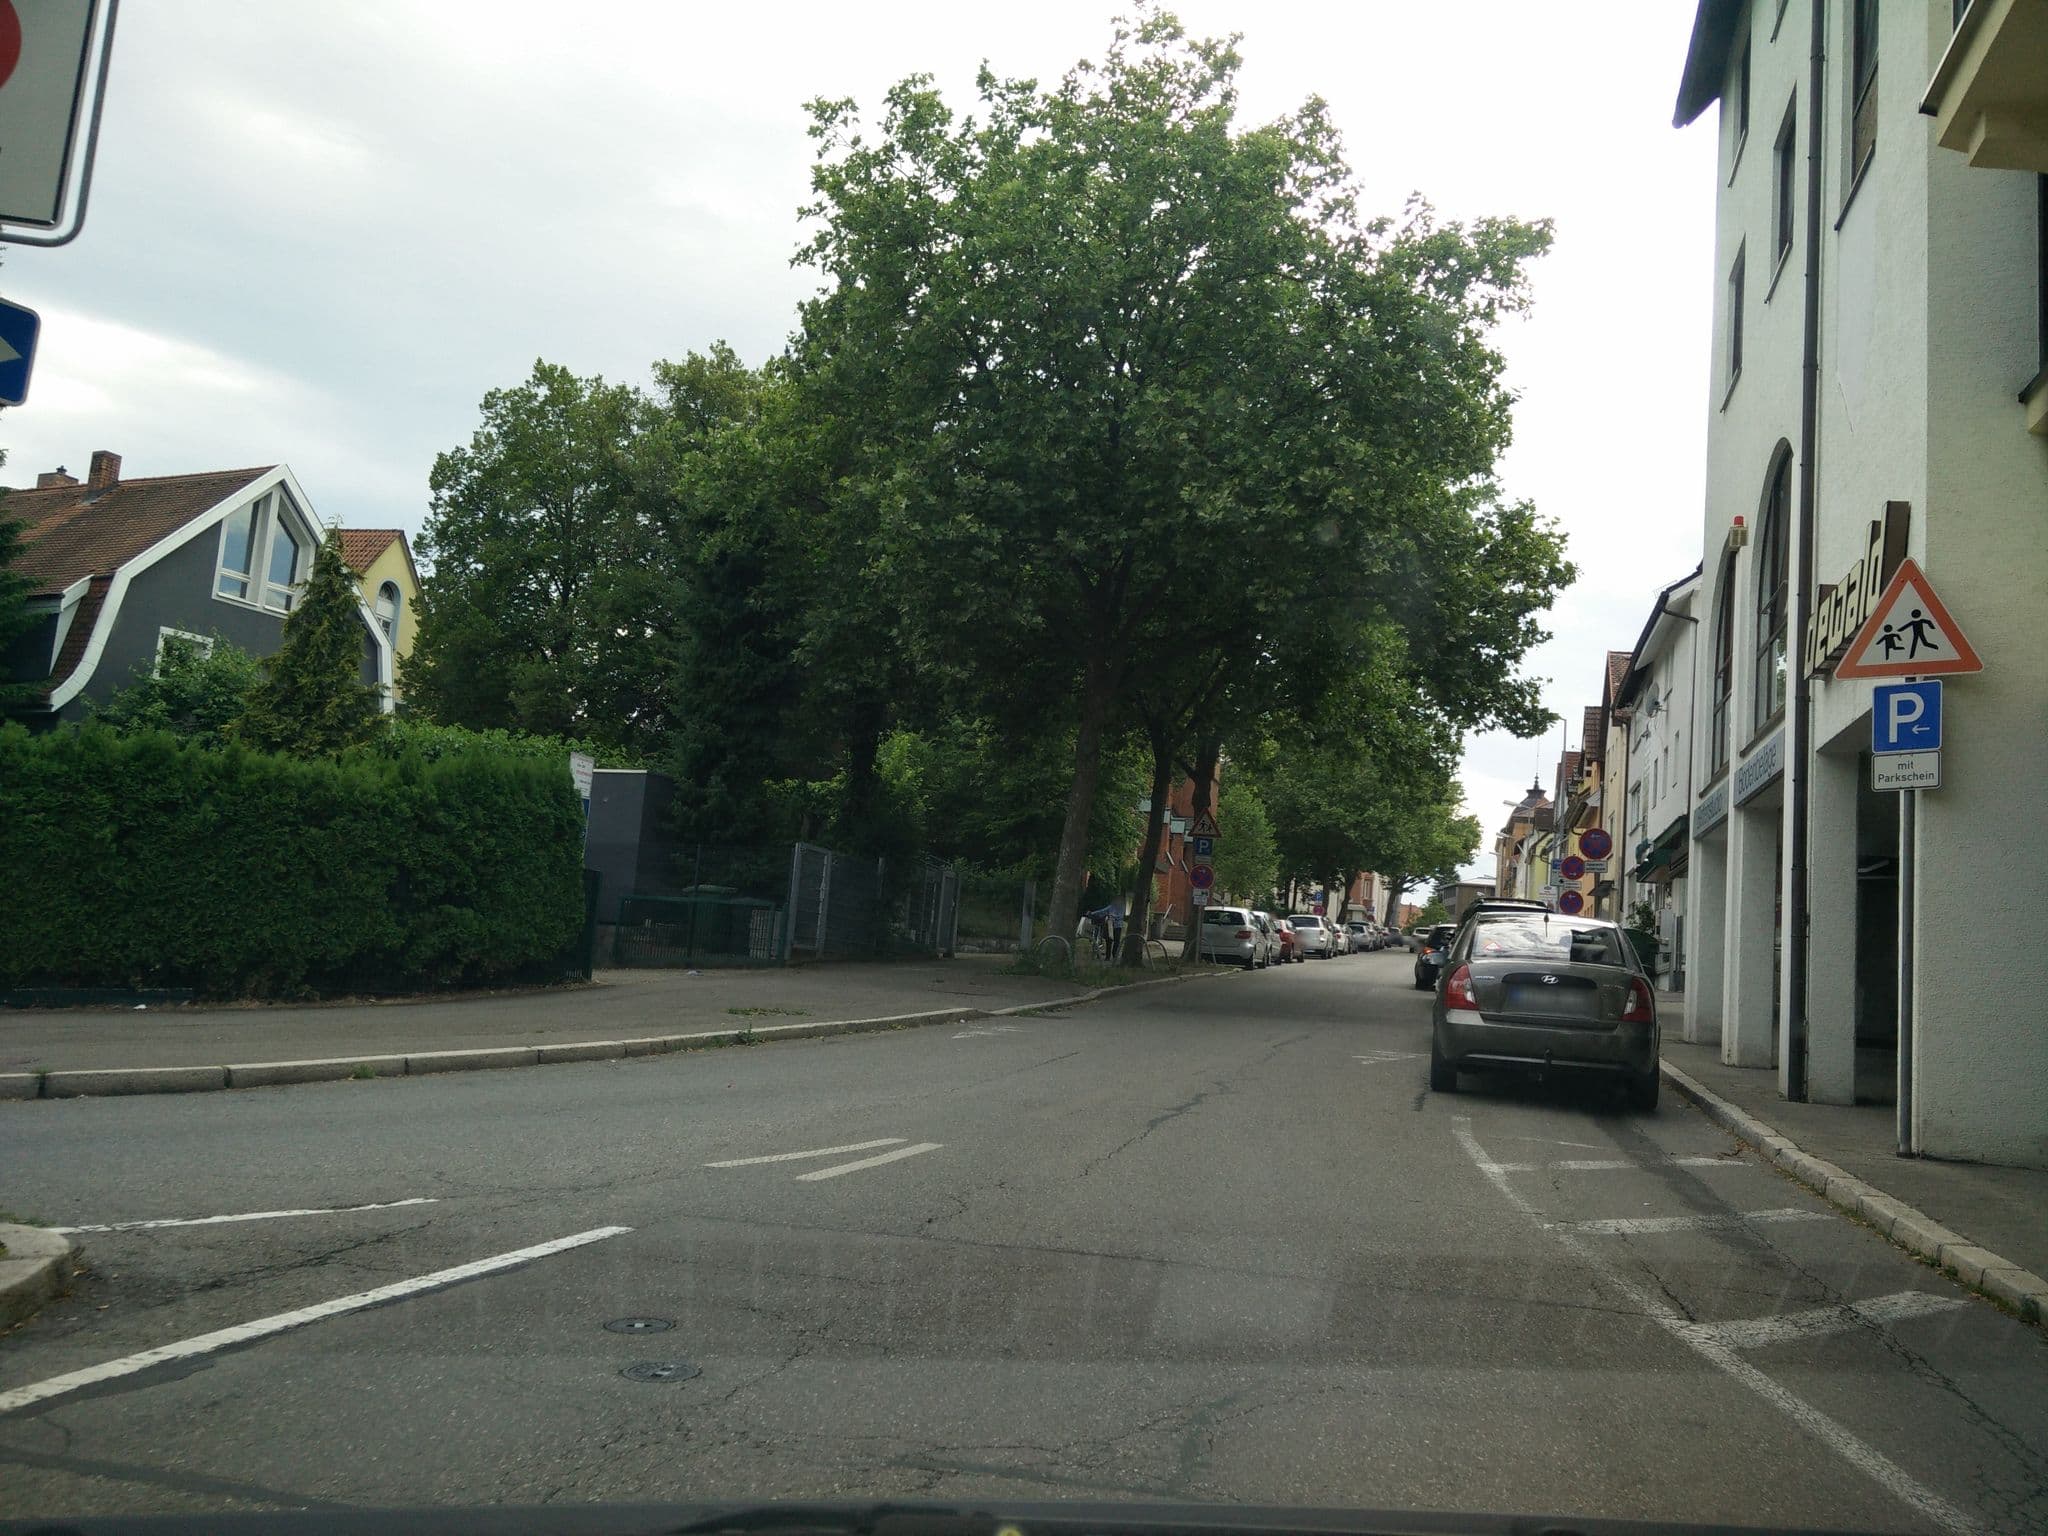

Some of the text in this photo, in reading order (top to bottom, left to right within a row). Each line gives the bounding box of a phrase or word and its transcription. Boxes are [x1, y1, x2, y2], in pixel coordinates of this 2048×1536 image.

[1889, 692, 1925, 743] P
[1897, 760, 1915, 770] mit
[1878, 771, 1935, 783] Parkschein
[1199, 840, 1209, 854] P
